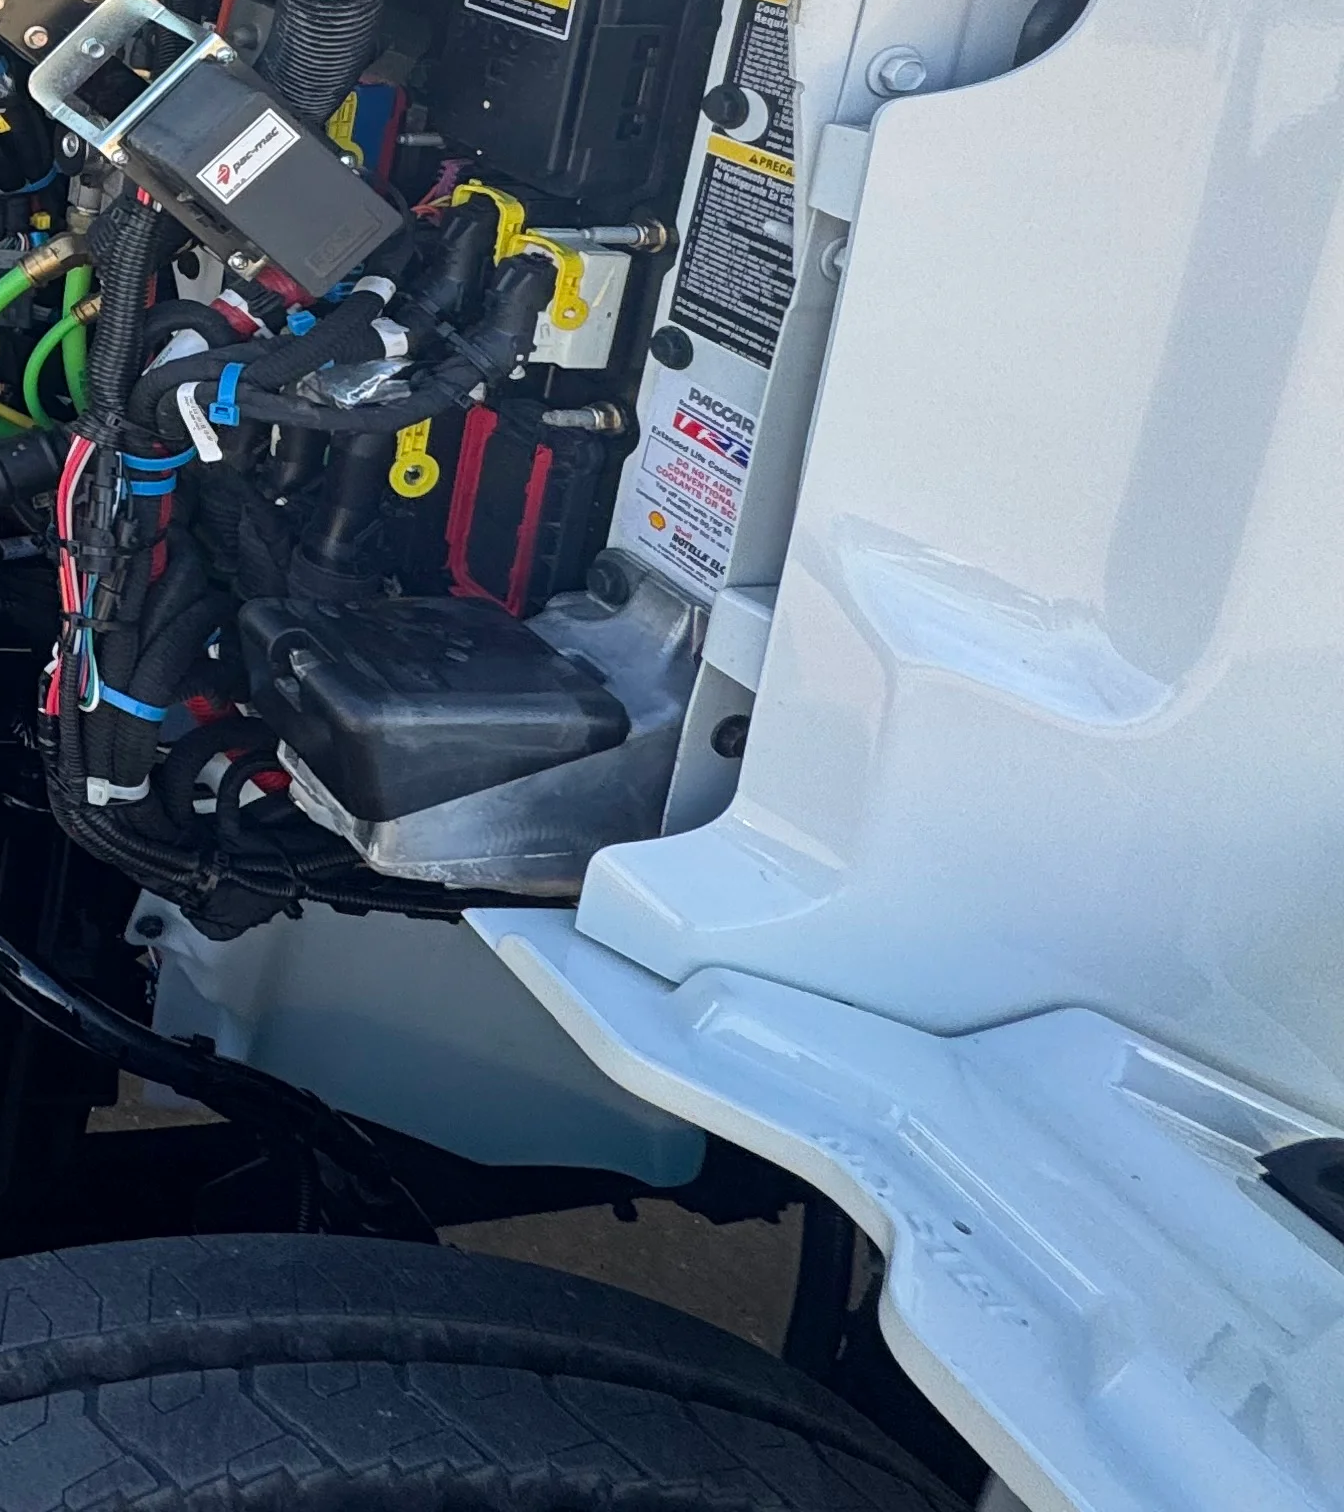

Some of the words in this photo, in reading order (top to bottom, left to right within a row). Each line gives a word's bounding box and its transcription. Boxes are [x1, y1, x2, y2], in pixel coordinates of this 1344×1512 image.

[756, 1, 788, 18] Coola
[688, 387, 755, 435] PACCAR
[652, 425, 689, 453] Extended
[708, 460, 742, 486] Coolant
[676, 457, 689, 469] DO
[691, 467, 711, 482] NOT
[712, 480, 733, 497] ADD
[655, 465, 702, 500] COOLANTS
[704, 496, 719, 509] OR
[668, 462, 737, 511] CONVENTIONAL
[672, 533, 710, 562] ROTELLA
